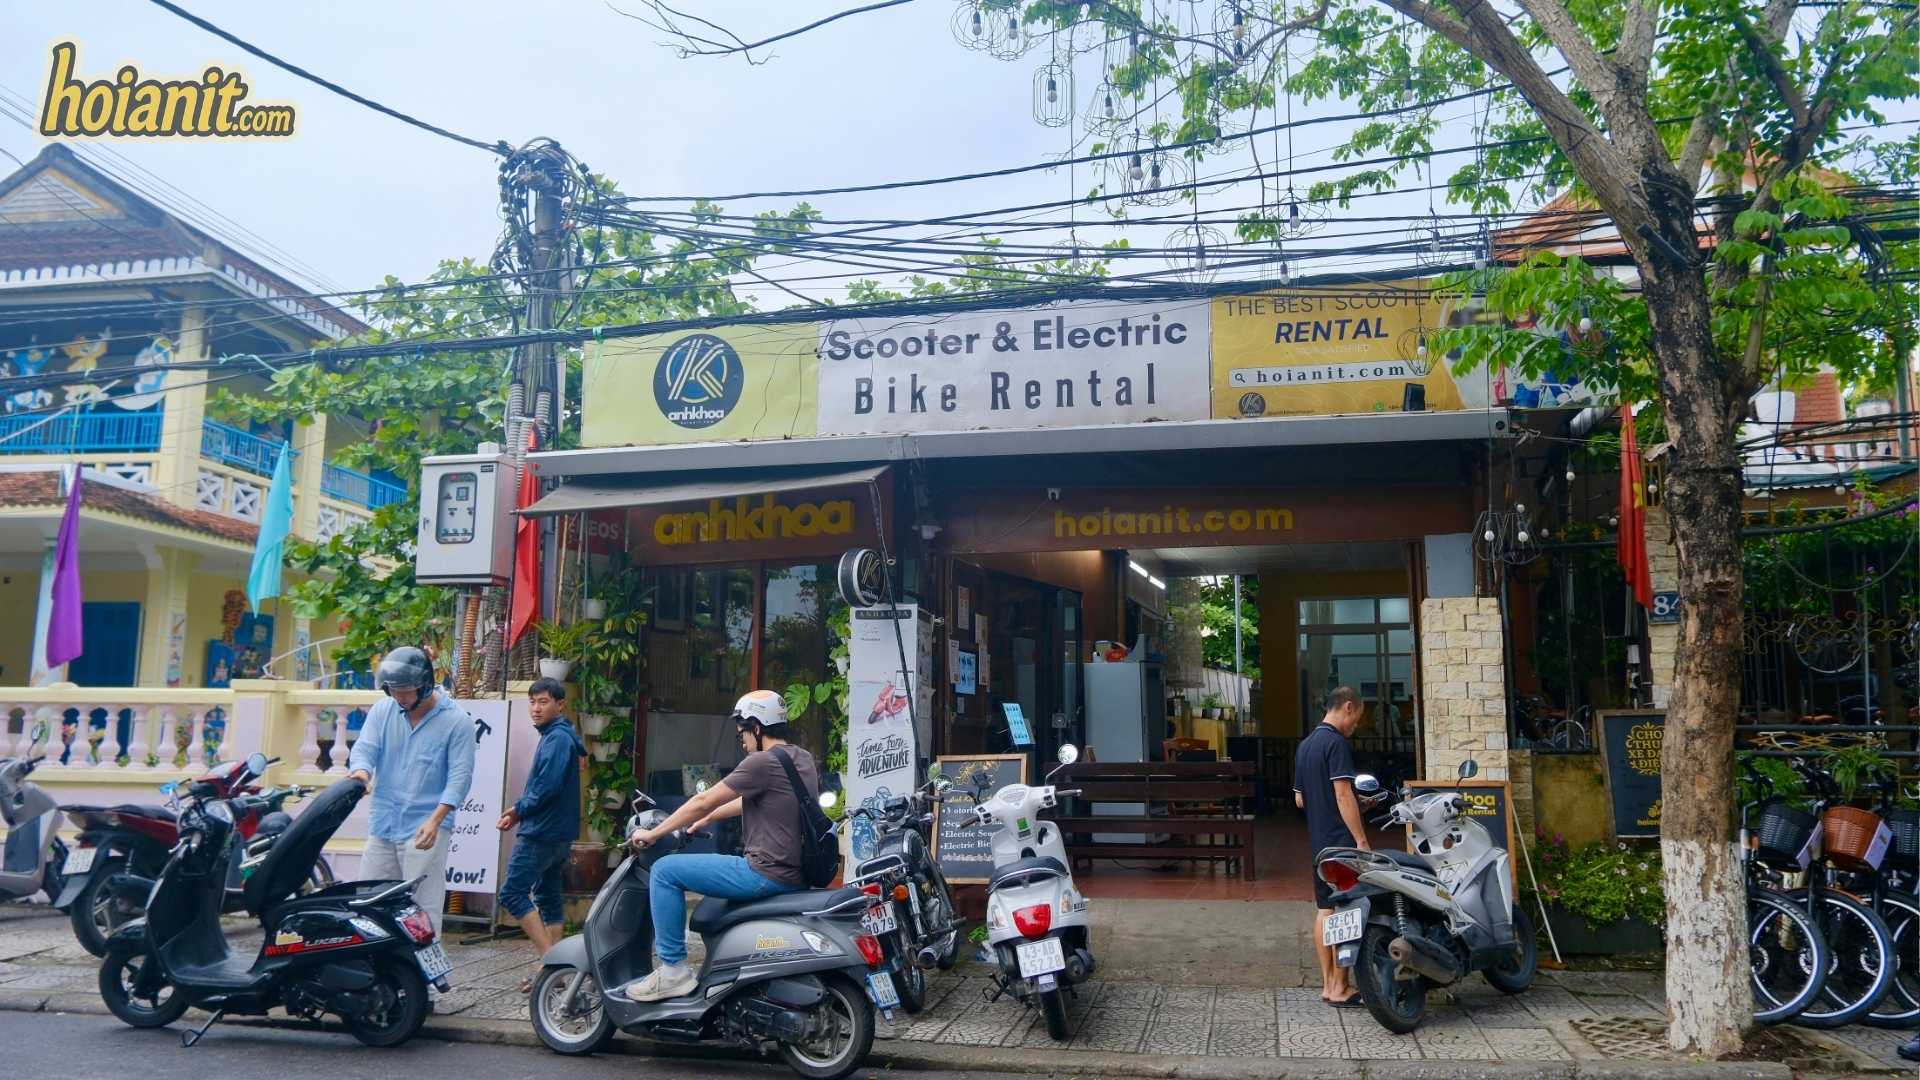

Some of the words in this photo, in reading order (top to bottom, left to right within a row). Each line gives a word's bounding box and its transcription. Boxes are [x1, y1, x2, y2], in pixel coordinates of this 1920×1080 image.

[1224, 299, 1266, 317] THE
[1272, 295, 1326, 314] BEST
[1335, 290, 1441, 311] SCOOTE
[827, 328, 980, 361] Scooter
[991, 321, 1020, 352] &
[1033, 314, 1188, 350] Electric
[1274, 316, 1389, 344] RENTAL
[854, 373, 957, 415] Bike
[990, 362, 1156, 411] Rental
[1256, 365, 1405, 384] hoianit.com
[668, 406, 725, 420] anhkhoa
[653, 492, 855, 545] anhkhoa
[1054, 505, 1294, 538] hoianit.com
[1632, 740, 1661, 749] THU
[858, 749, 910, 777] ADVENTURE
